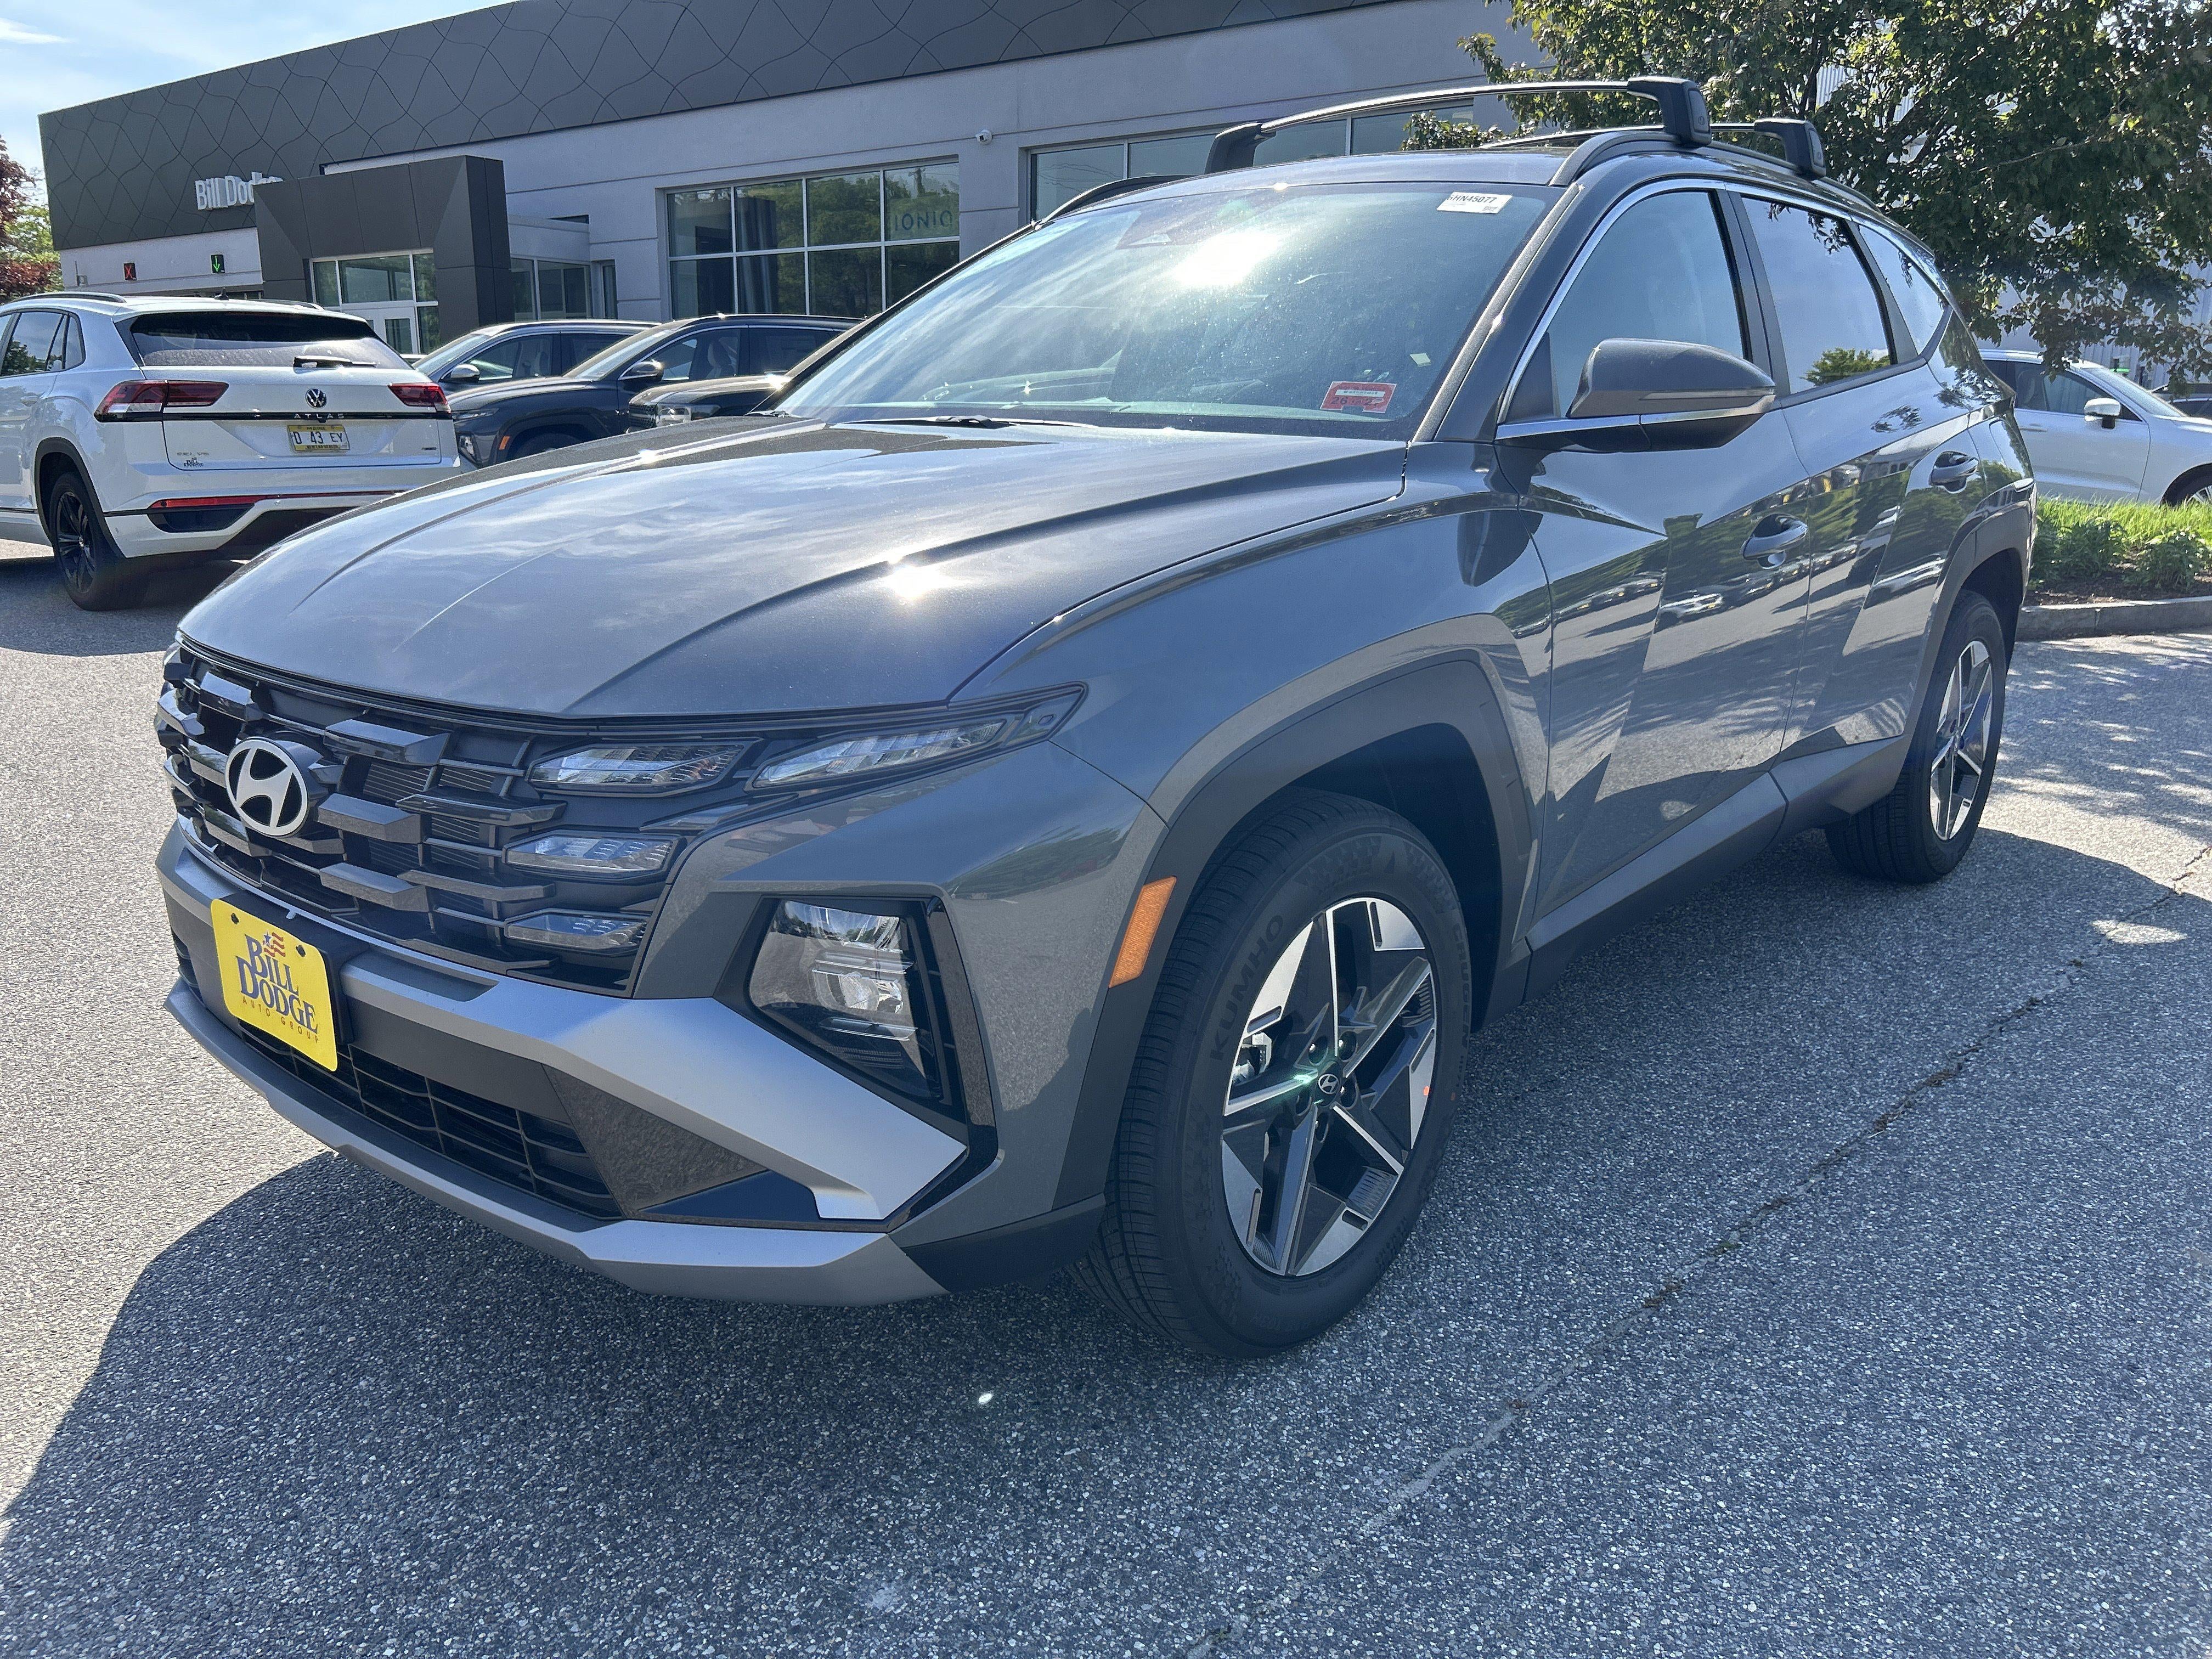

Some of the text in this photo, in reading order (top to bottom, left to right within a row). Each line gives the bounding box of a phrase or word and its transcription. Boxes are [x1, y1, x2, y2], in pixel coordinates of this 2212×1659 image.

[195, 178, 226, 210] Bill
[235, 955, 318, 1034] DODGE
[244, 934, 300, 997] BILL
[1210, 915, 1284, 1061] KUMHO
[242, 996, 318, 1043] AUTO GROUP
